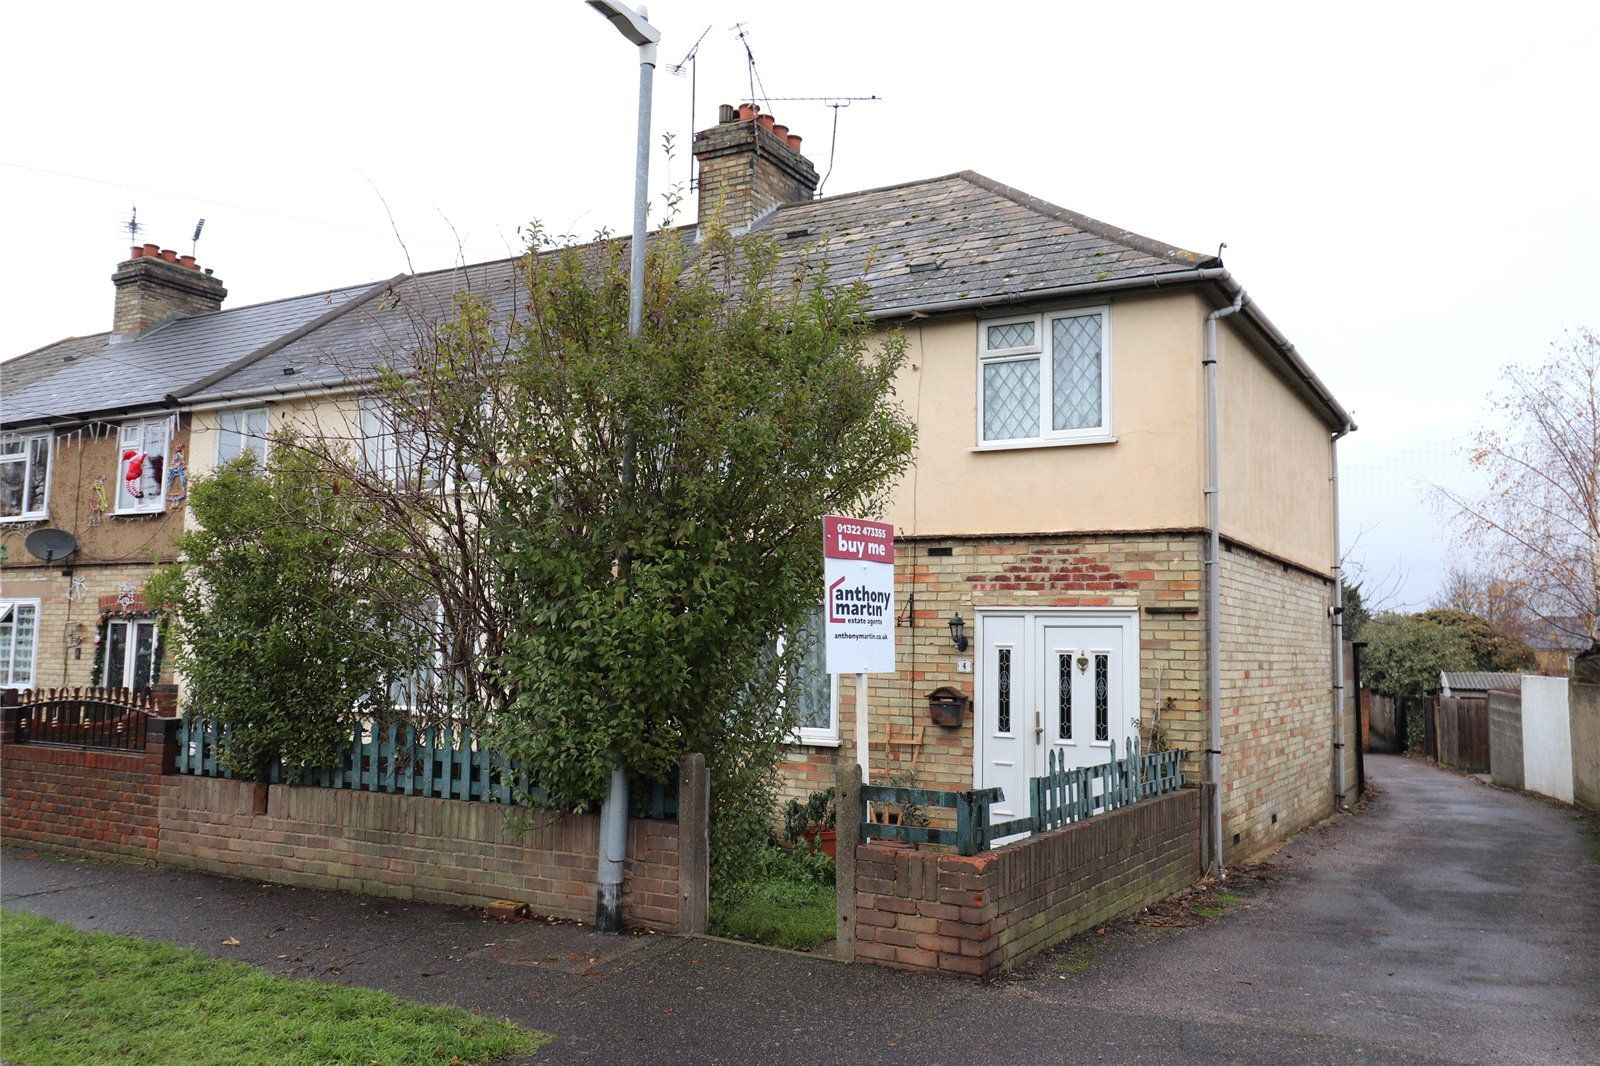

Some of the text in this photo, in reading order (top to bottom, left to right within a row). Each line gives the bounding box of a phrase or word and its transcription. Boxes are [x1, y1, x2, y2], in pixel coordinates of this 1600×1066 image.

[837, 524, 886, 539] 01322 473355
[838, 534, 886, 558] buy me
[835, 585, 891, 611] anthony
[835, 602, 882, 617] martin
[867, 619, 883, 627] agents
[834, 632, 888, 641] anthonymartin.co.uk
